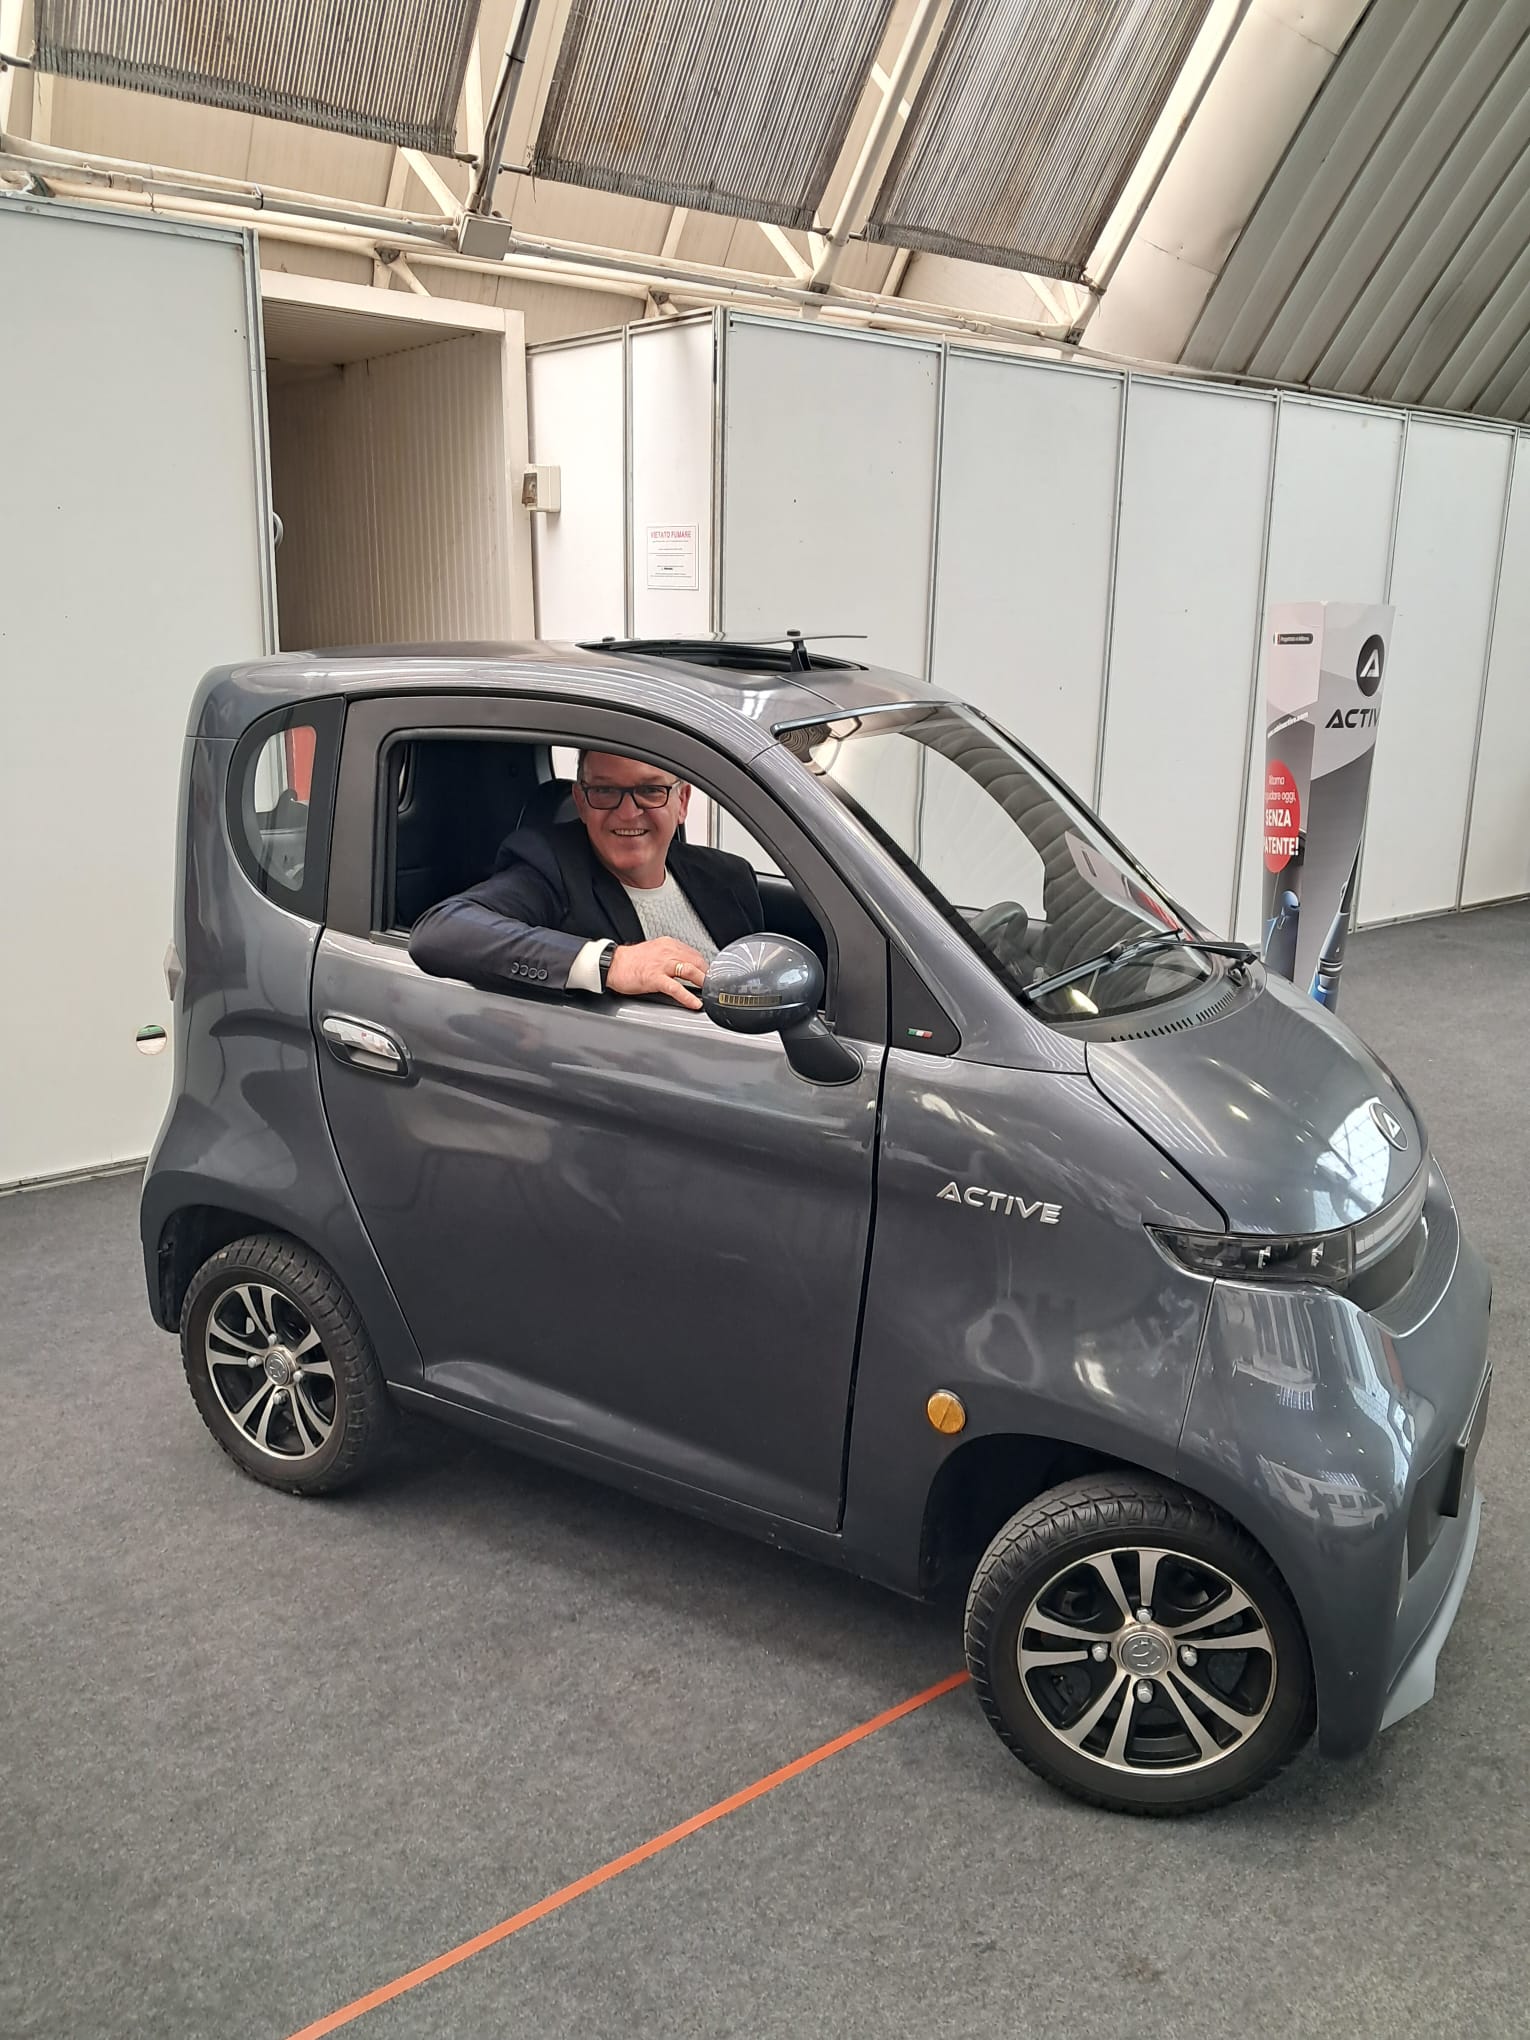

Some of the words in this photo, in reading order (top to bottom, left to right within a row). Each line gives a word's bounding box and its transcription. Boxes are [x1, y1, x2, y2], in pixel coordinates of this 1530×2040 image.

[1325, 708, 1379, 728] ACTIV
[1265, 808, 1291, 827] SENZA
[1264, 837, 1299, 856] ATENTE!
[936, 1181, 1063, 1224] ACTIVE
